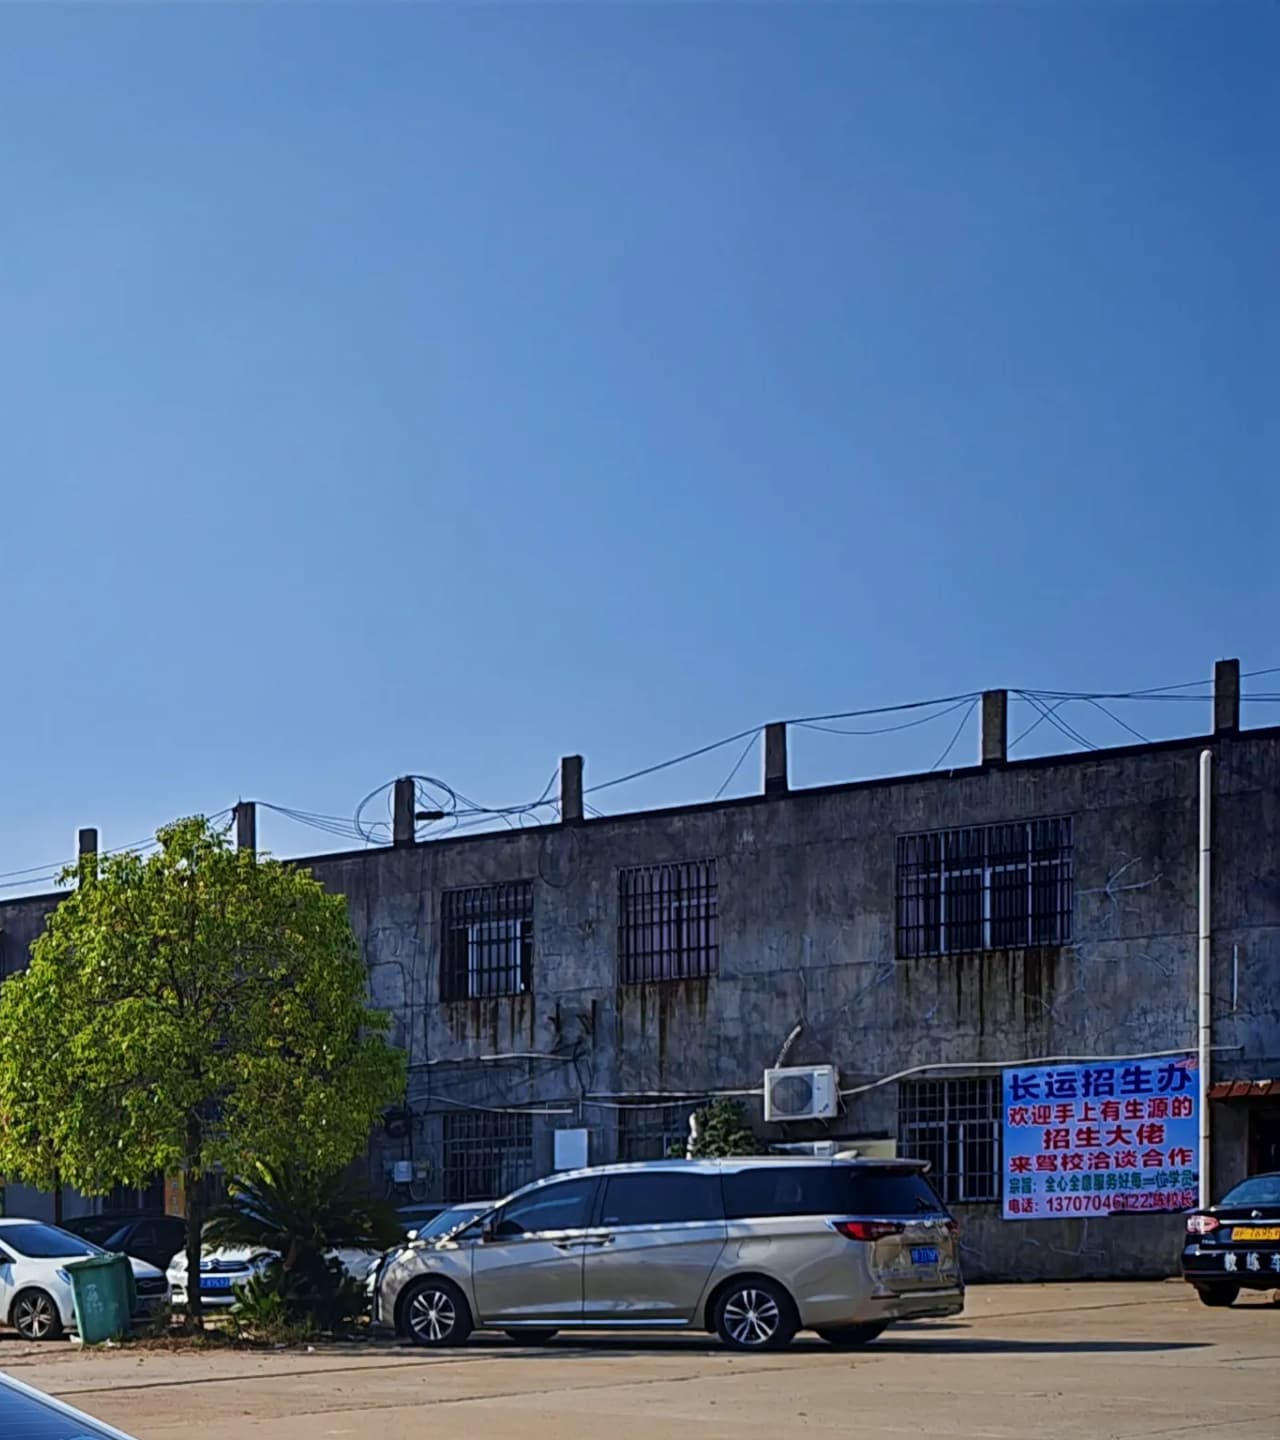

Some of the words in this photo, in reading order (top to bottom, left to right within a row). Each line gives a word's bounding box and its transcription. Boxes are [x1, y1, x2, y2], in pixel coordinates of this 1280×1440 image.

[1008, 1064, 1192, 1101] 长运招生办
[1008, 1095, 1193, 1127] 欢迎手上有生源的
[1043, 1123, 1165, 1150] 招生大佬
[1008, 1147, 1193, 1173] 来驾校洽谈合作
